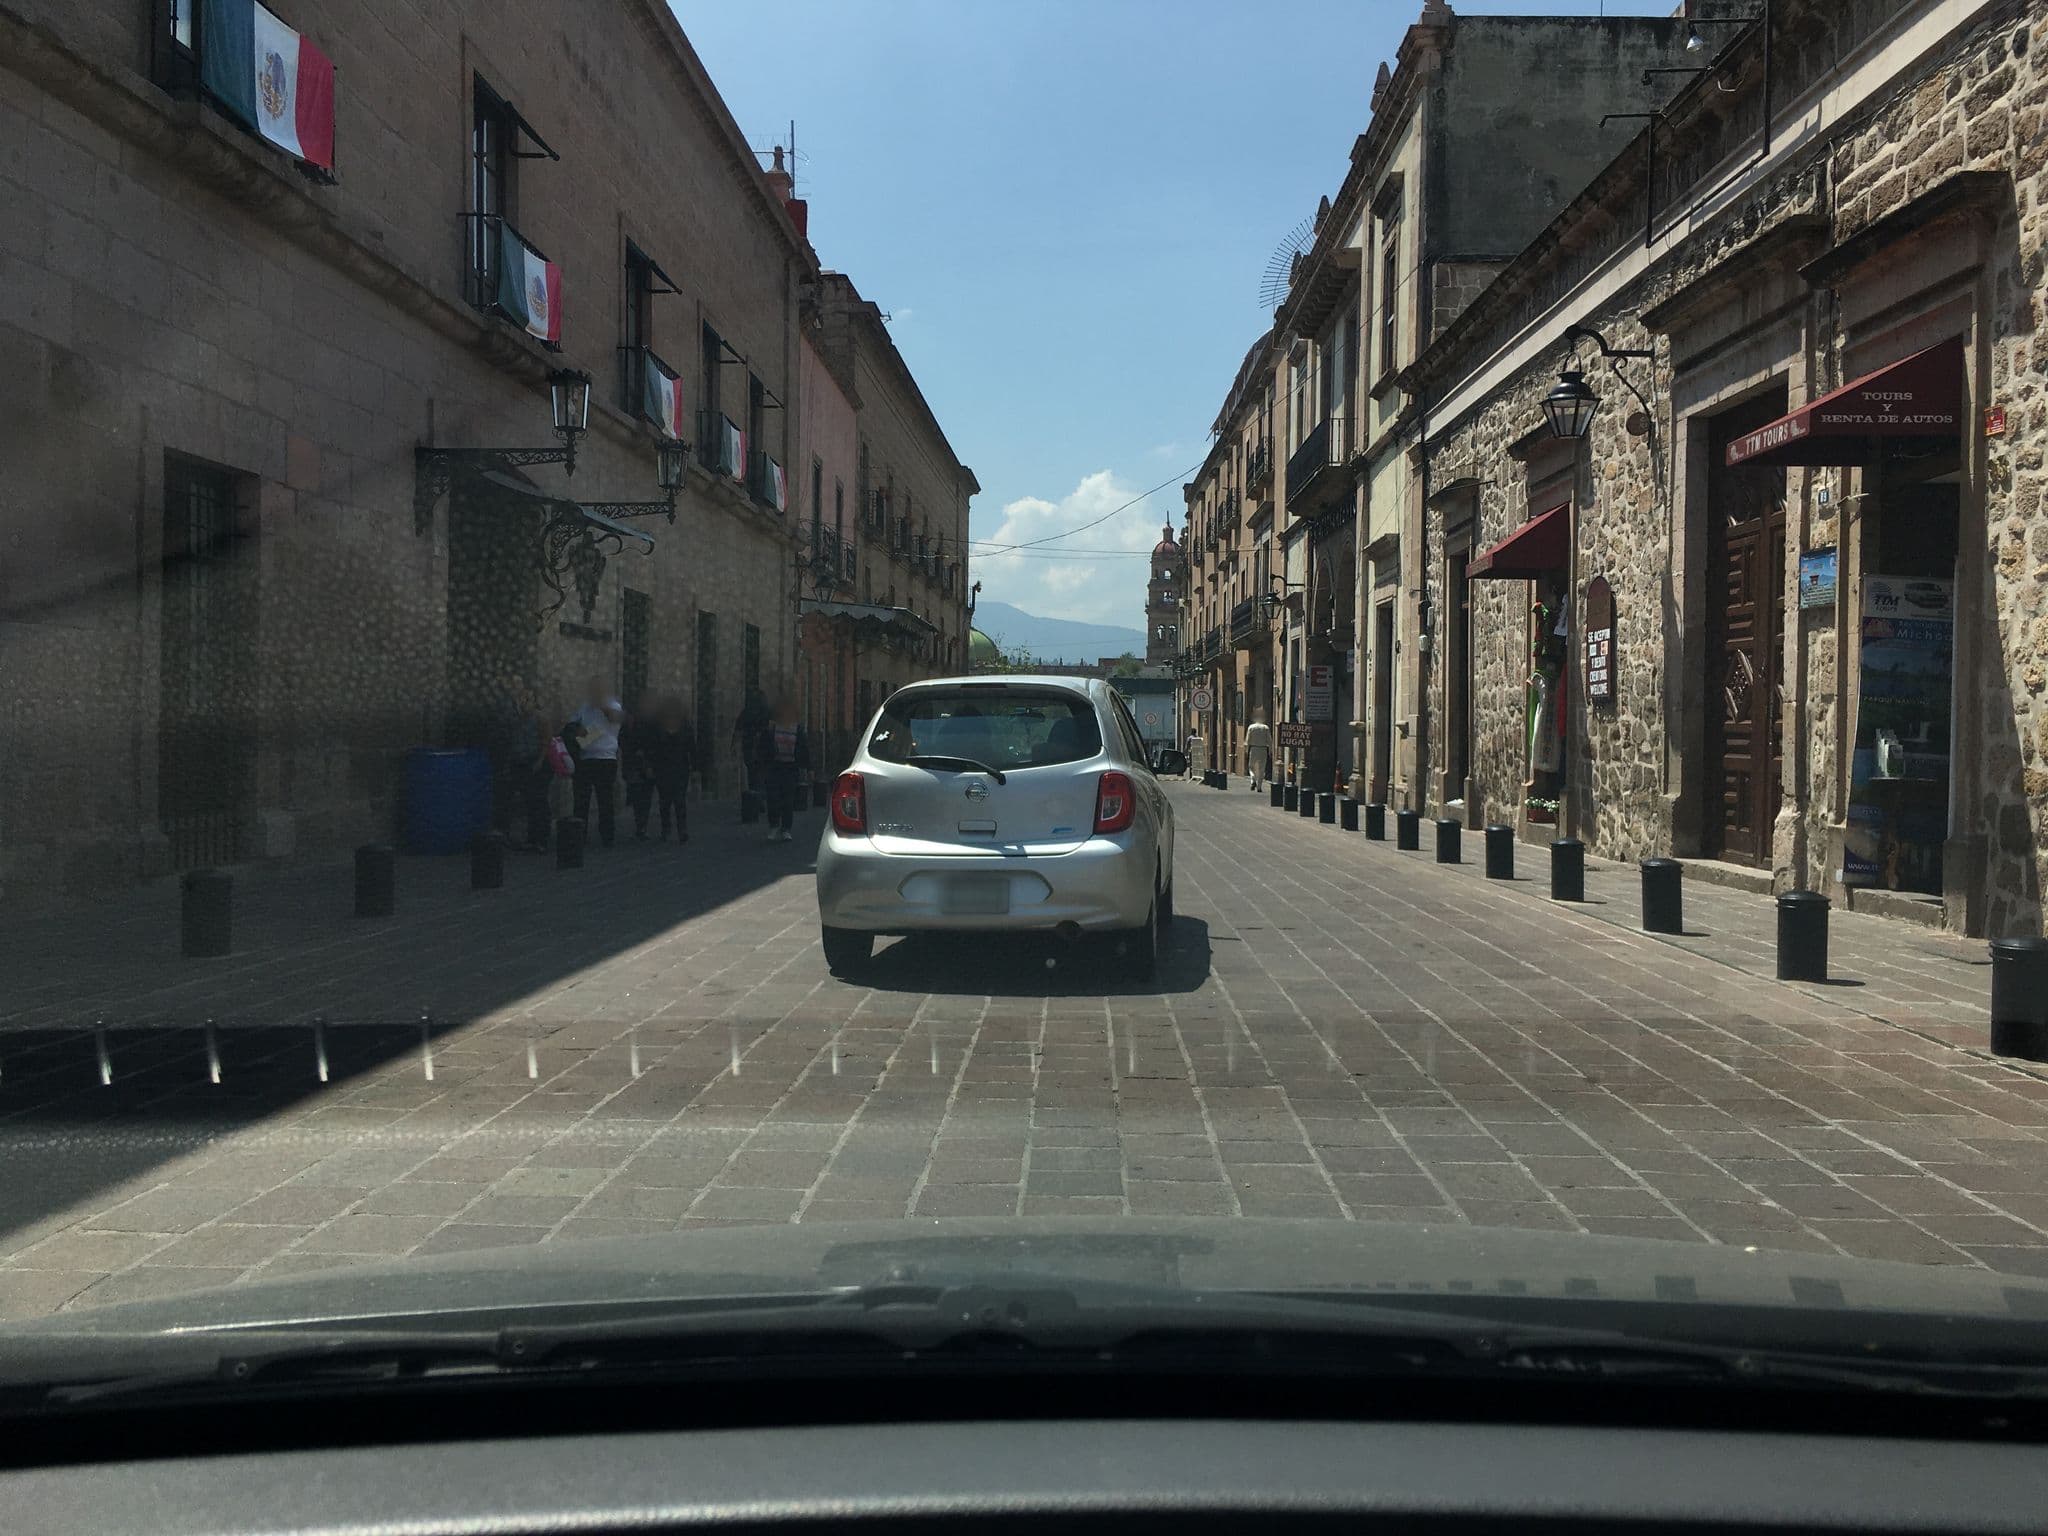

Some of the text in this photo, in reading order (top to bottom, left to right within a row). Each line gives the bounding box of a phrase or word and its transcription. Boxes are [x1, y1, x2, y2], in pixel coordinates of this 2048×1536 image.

[1862, 392, 1913, 401] TOURS
[1882, 404, 1893, 412] Y
[1821, 414, 1953, 423] RENTA DE AUTOS
[1763, 423, 1789, 448] TOURS
